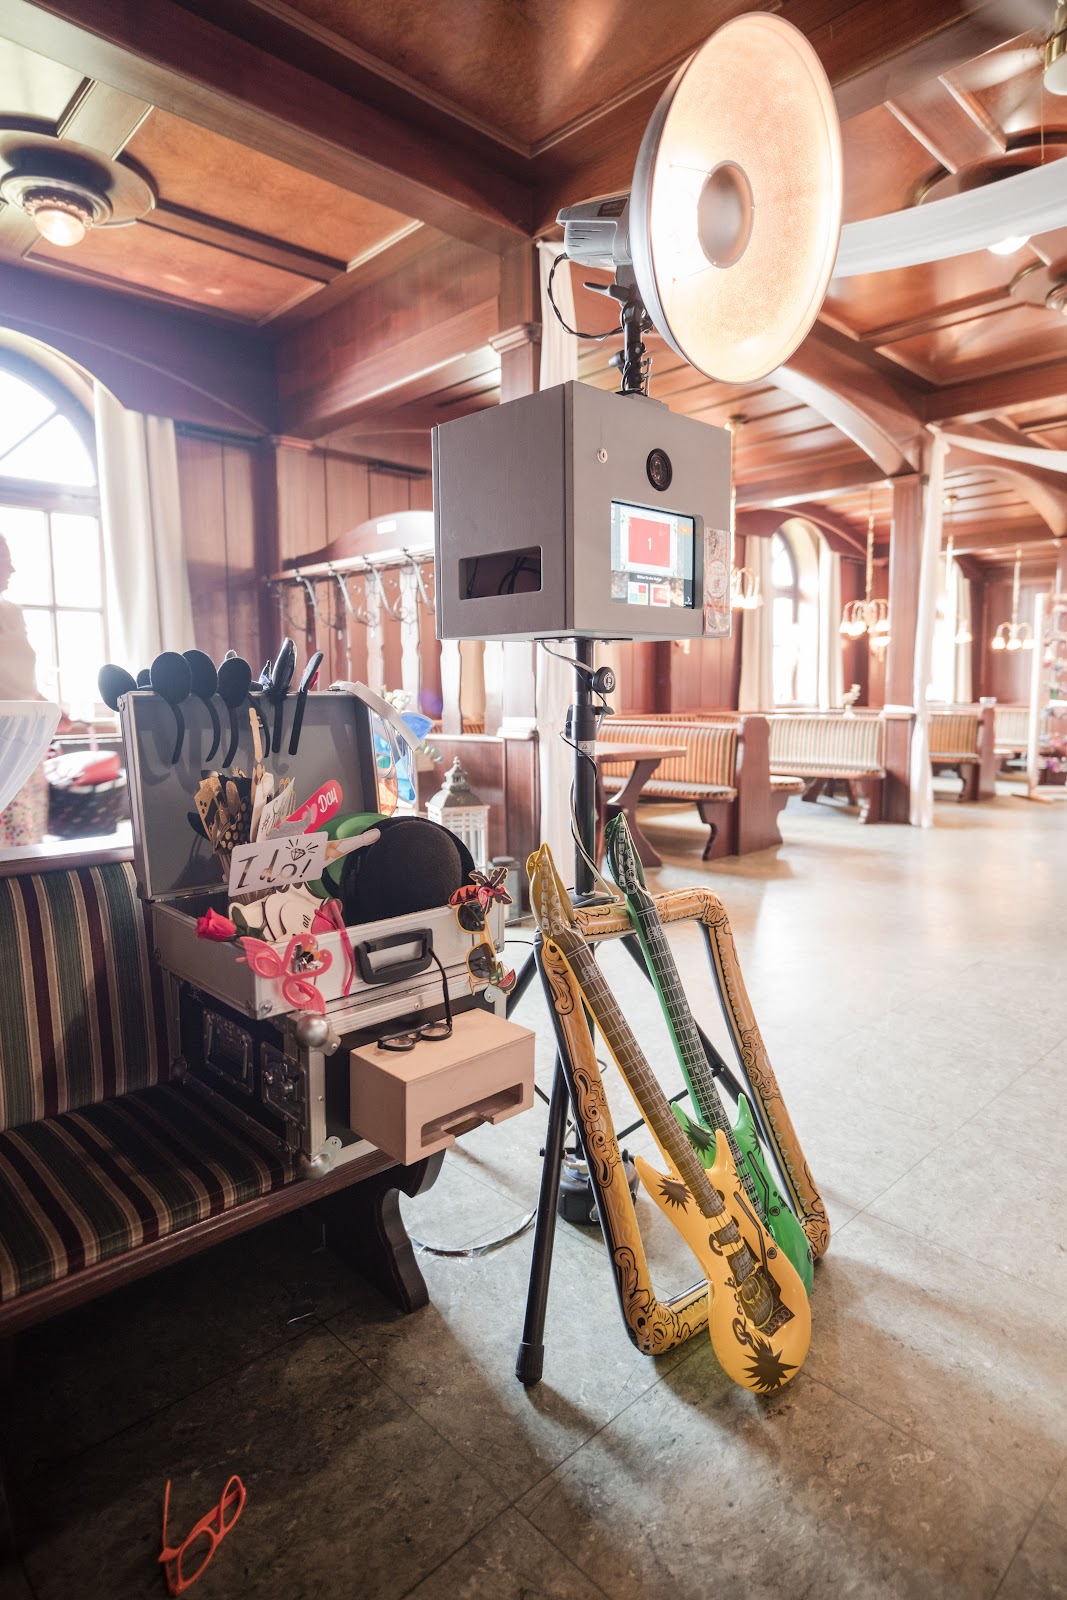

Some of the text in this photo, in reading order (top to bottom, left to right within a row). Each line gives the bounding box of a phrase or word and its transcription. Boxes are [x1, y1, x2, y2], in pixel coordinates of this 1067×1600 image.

[647, 537, 652, 551] 1
[317, 787, 339, 813] Day
[235, 848, 312, 890] I do!
